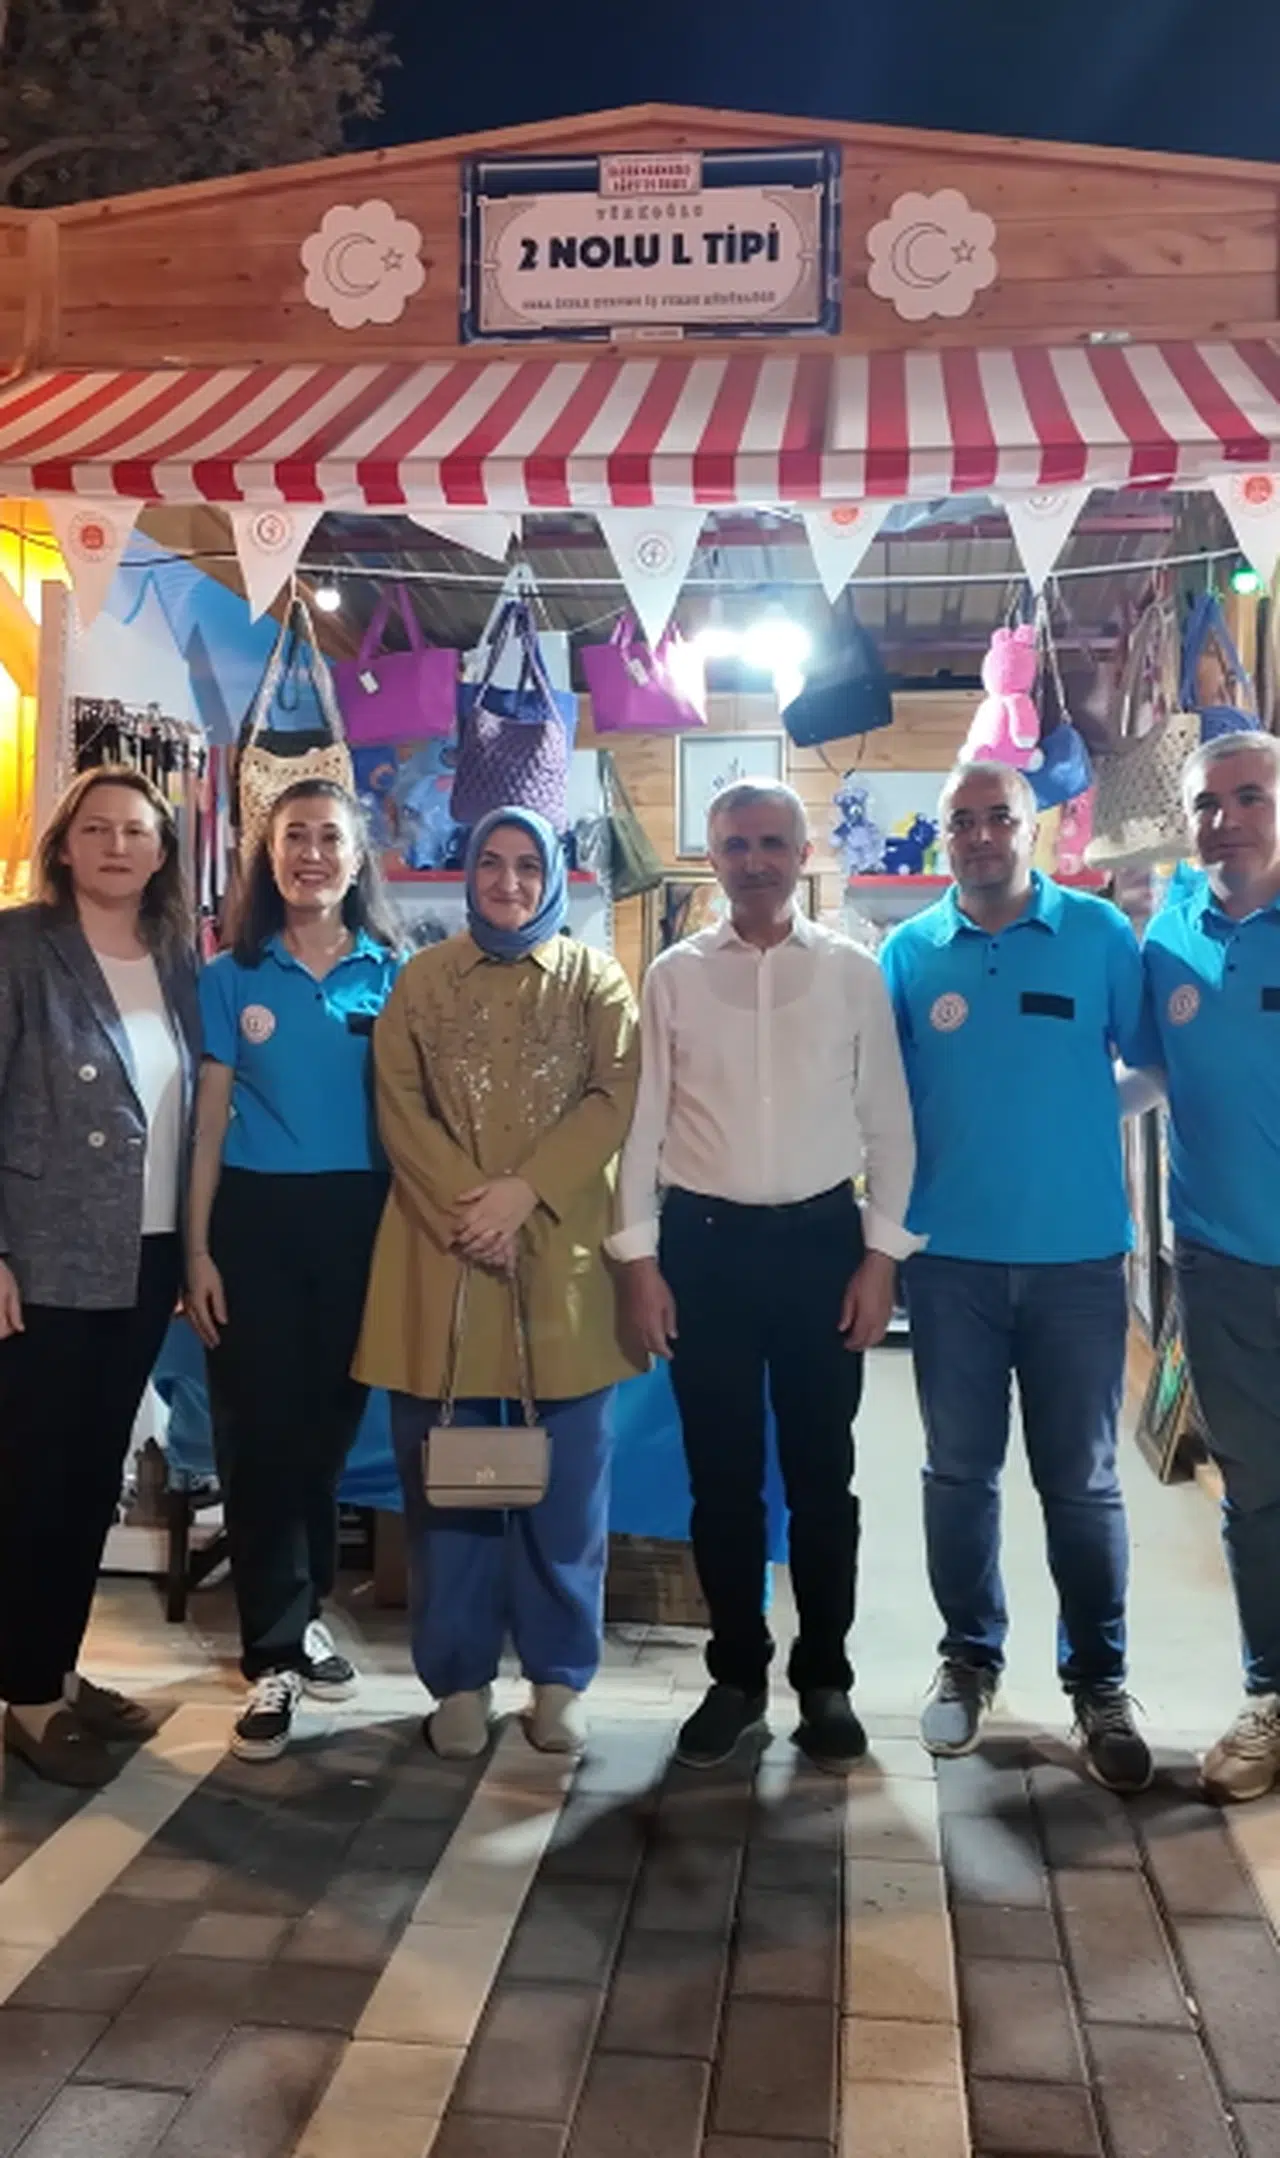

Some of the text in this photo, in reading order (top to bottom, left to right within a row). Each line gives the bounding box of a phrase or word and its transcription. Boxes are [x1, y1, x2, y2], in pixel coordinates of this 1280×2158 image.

[518, 222, 779, 271] 2 NOLU L TİPİ
